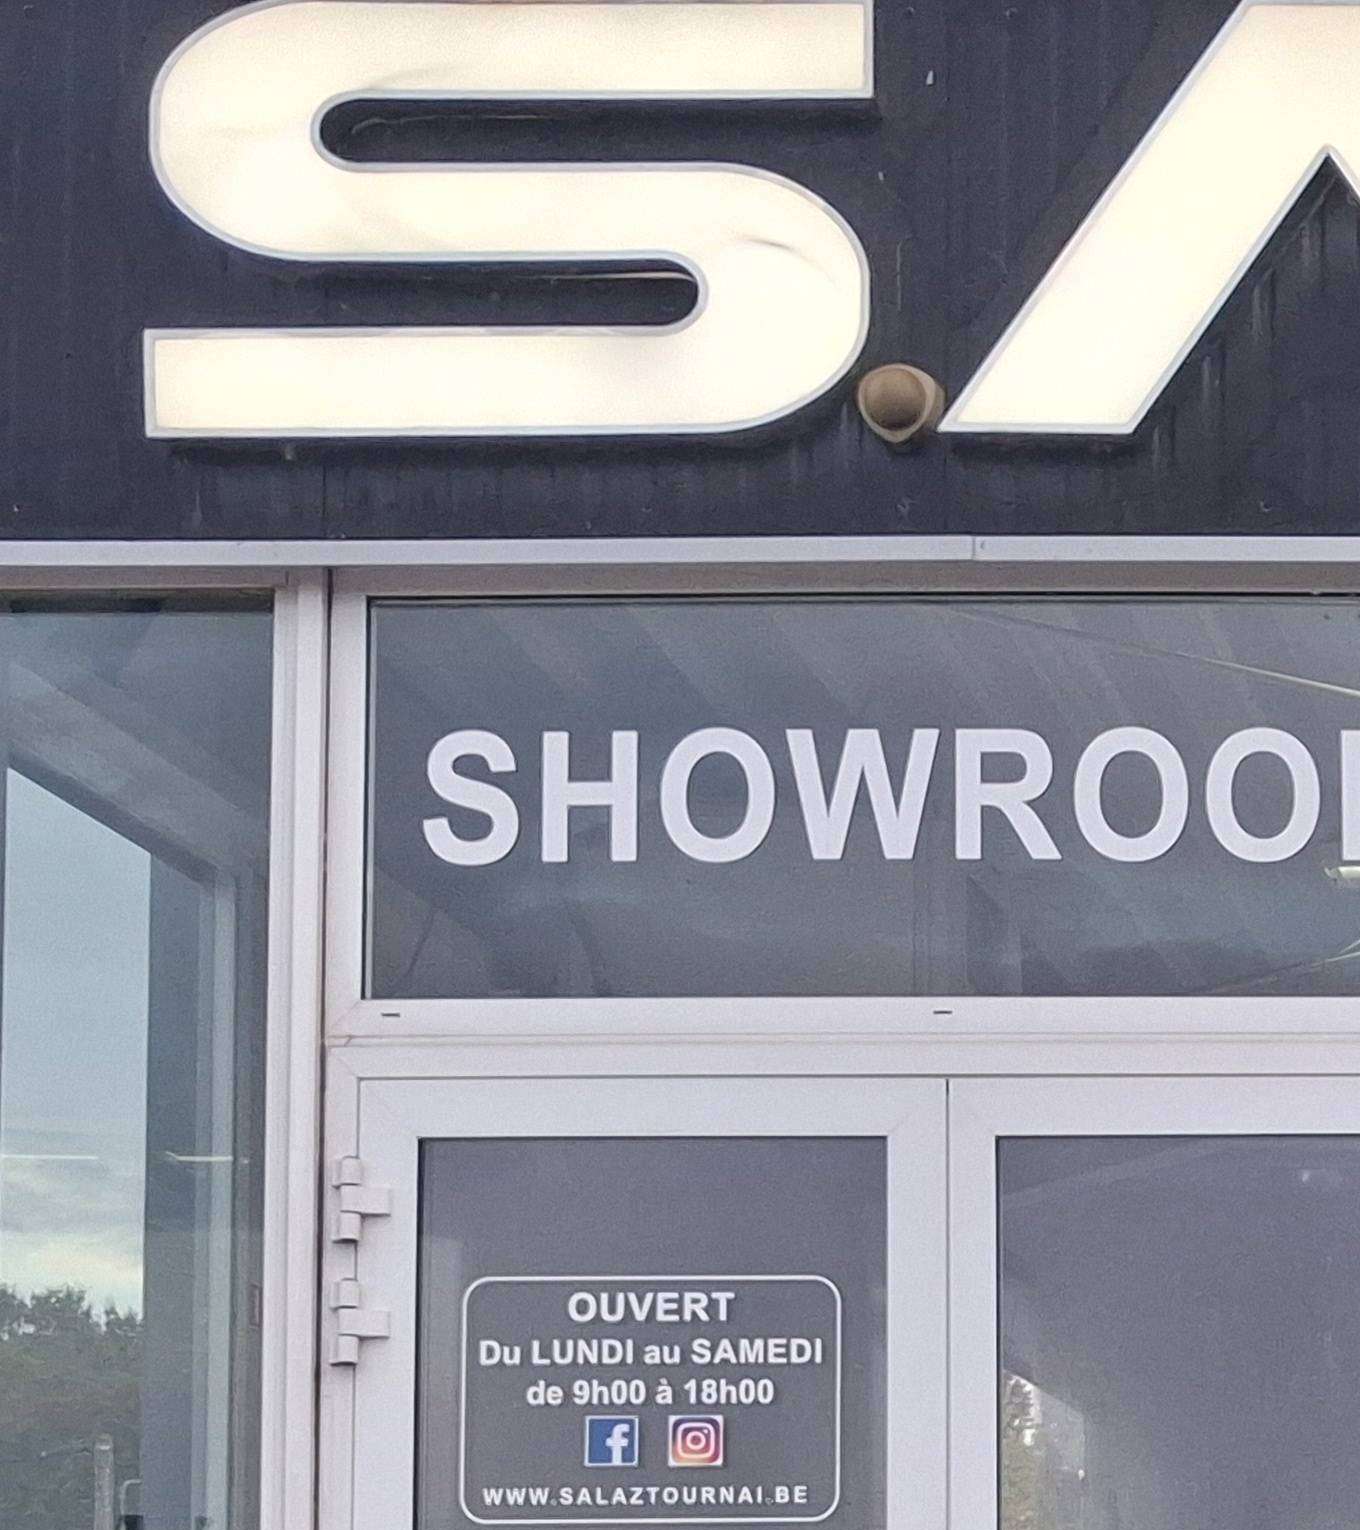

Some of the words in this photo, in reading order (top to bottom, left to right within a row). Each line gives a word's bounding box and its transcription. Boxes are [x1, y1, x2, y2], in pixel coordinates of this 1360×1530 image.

[568, 1291, 736, 1323] OUVERT
[479, 1340, 521, 1366] Du
[532, 1339, 634, 1365] LUNDI
[643, 1344, 681, 1365] au
[691, 1337, 822, 1364] SAMEDI
[526, 1379, 563, 1405] de
[573, 1379, 646, 1405] 9h00
[655, 1378, 673, 1404] à
[684, 1378, 774, 1405] 18h00
[483, 1485, 808, 1506] WWW.SALAZTOURNAI.BE
